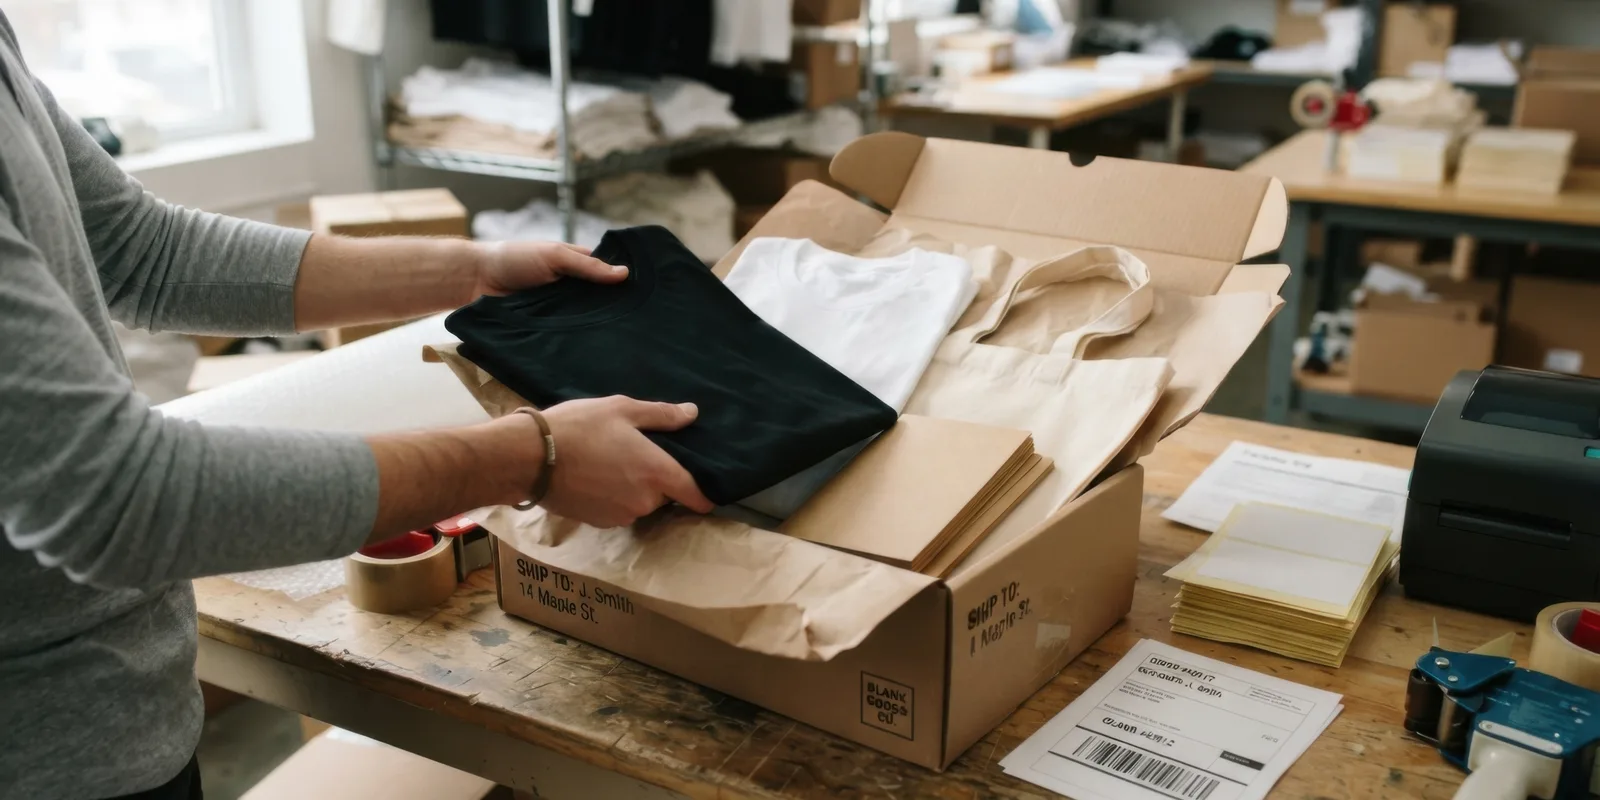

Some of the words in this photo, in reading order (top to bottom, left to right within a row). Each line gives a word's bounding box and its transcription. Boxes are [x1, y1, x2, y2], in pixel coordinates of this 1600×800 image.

[516, 558, 549, 583] SHIP
[579, 582, 591, 600] J.
[519, 582, 534, 600] 14
